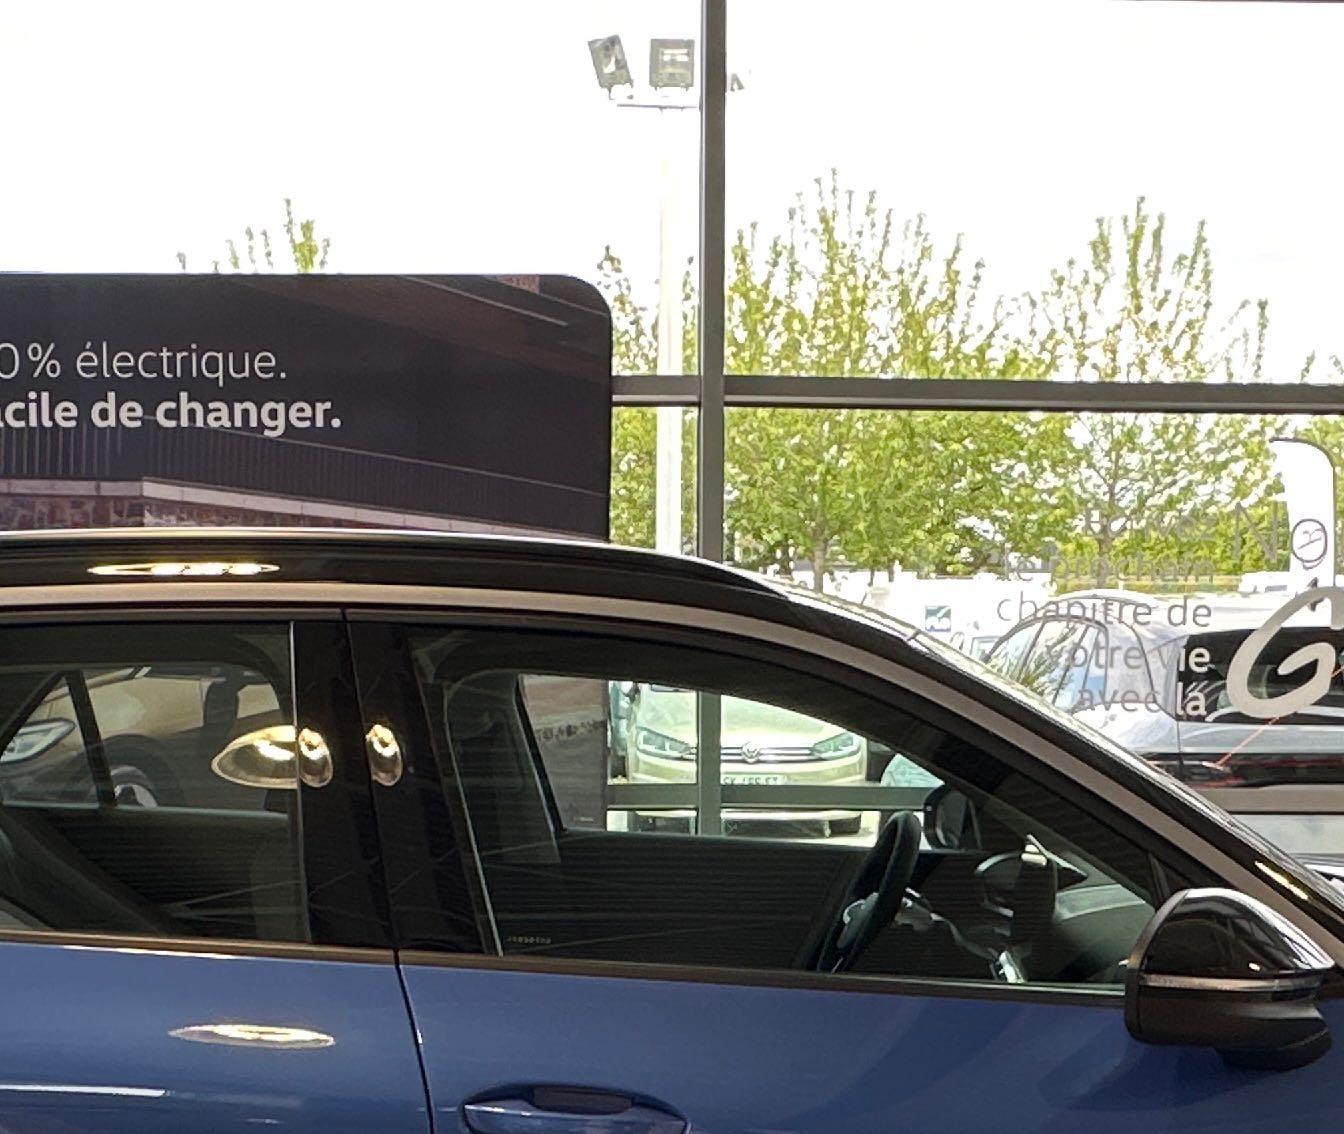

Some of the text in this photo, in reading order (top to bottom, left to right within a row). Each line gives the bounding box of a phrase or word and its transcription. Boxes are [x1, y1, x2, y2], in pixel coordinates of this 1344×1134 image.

[76, 340, 287, 388] électrique.
[91, 391, 144, 428] de
[156, 391, 342, 437] changer.
[996, 590, 1213, 632] chapitre de
[1158, 642, 1212, 673] vie
[1075, 682, 1208, 717] avec la
